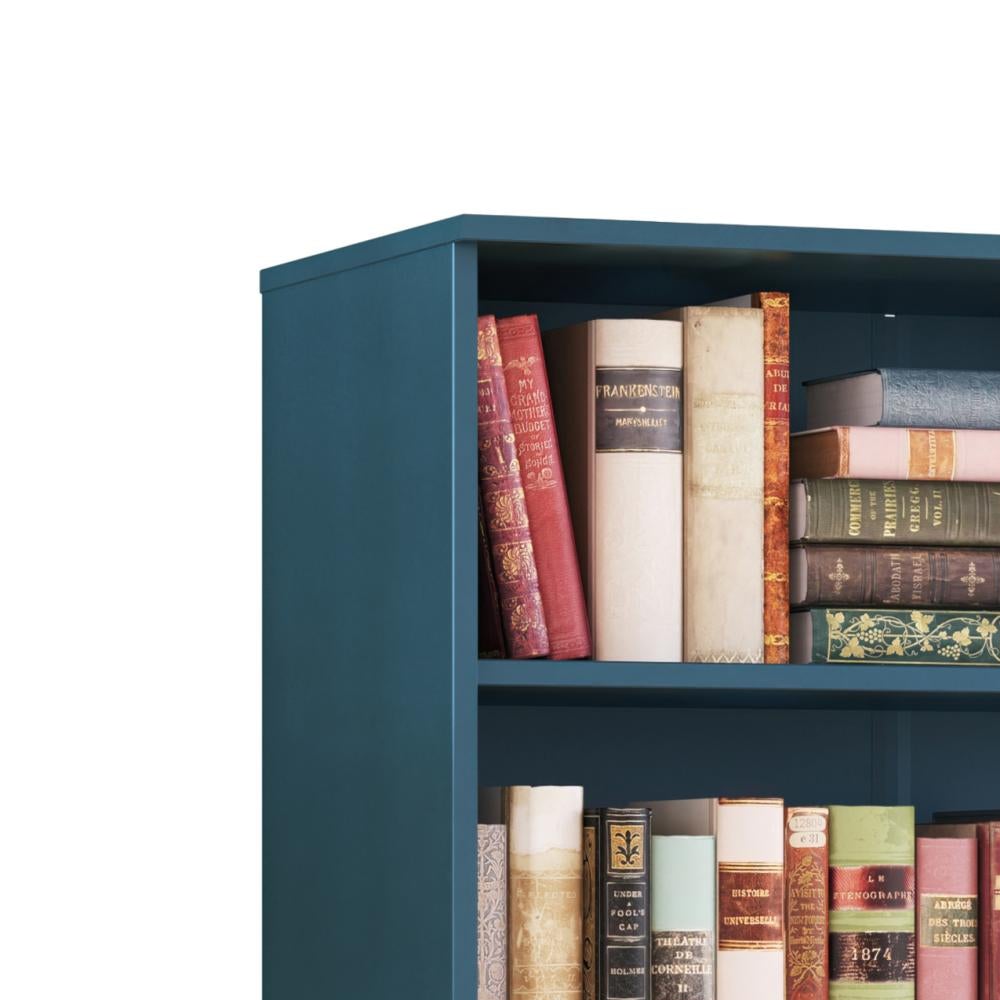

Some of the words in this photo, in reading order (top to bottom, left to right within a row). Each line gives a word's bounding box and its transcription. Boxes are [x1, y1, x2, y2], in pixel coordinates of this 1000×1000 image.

[518, 379, 534, 392] MY
[773, 383, 787, 392] DE
[596, 383, 680, 399] FRANKENSTEIN
[869, 490, 877, 507] THE
[869, 510, 877, 521] OF
[613, 890, 642, 898] UNDER
[731, 889, 770, 898] HISTOIRE
[610, 909, 646, 917] FOOL'S
[723, 916, 779, 926] UNIVERSELL
[928, 918, 948, 927] DES
[618, 923, 639, 931] CAP
[674, 951, 693, 959] DE
[851, 948, 892, 961] 1874
[652, 964, 712, 974] CORNEILLE
